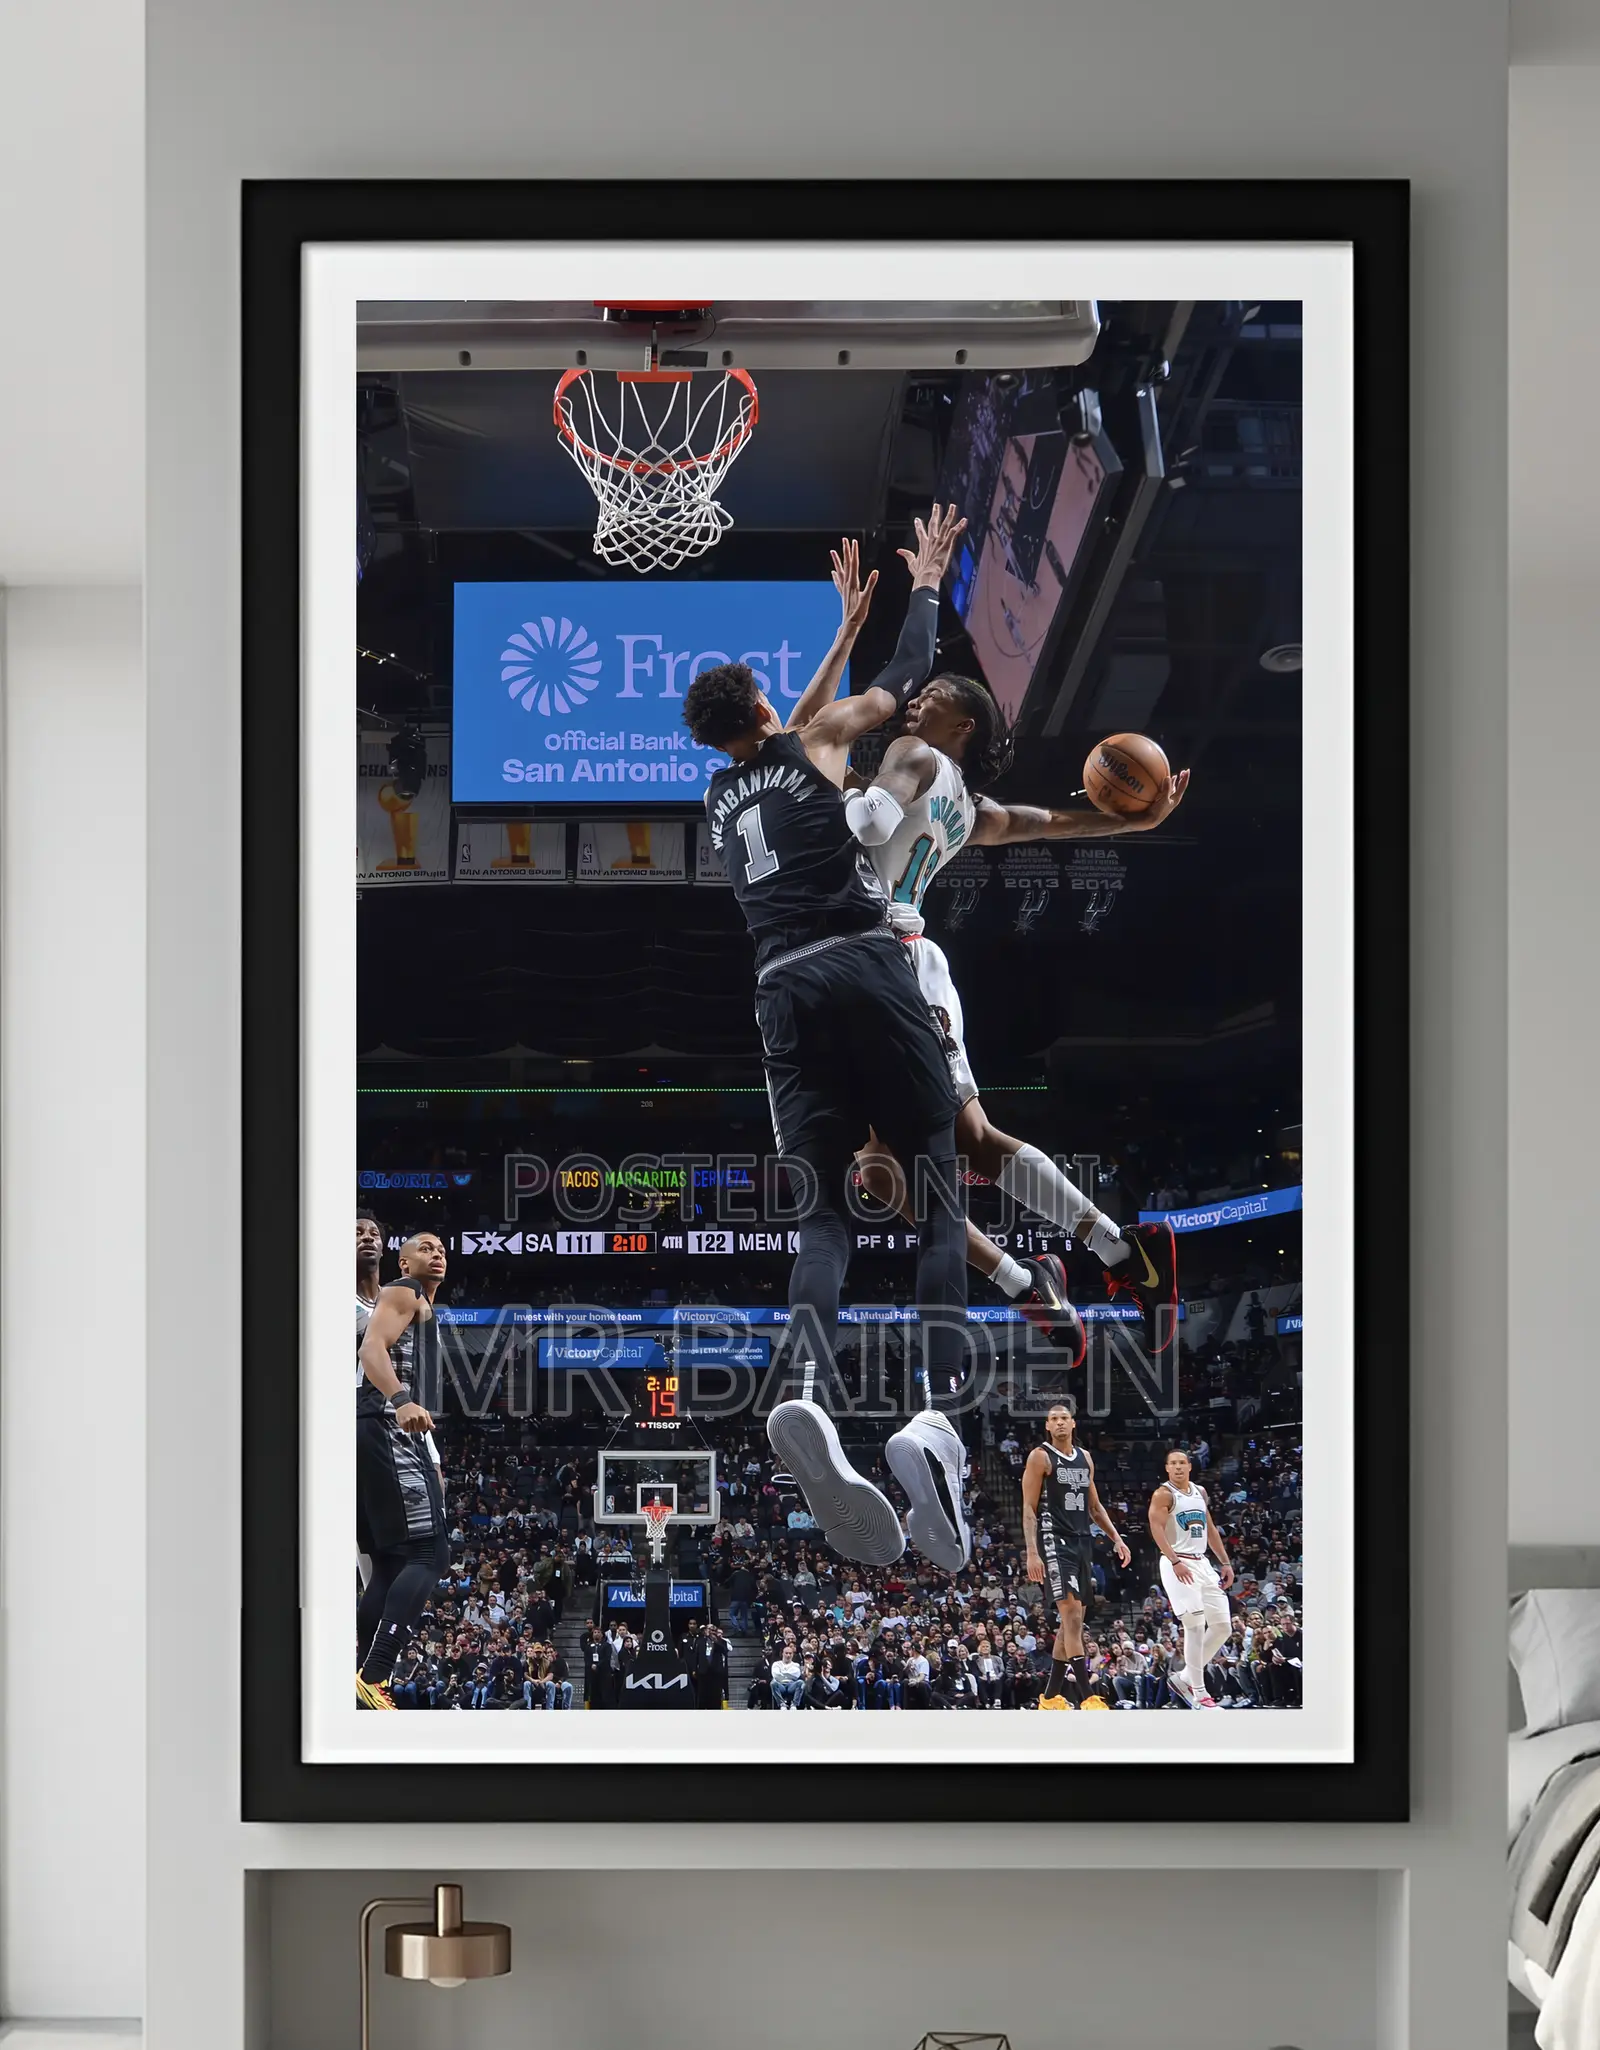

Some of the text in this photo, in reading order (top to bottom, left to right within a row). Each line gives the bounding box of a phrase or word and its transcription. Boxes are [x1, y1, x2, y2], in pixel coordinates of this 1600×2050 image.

[544, 730, 625, 750] Official
[630, 732, 687, 750] Bank
[502, 758, 565, 783] San
[570, 755, 699, 783] Antonio
[711, 765, 818, 851] WEMBANYAMA
[736, 802, 780, 885] 1
[936, 878, 989, 888] 2007
[1004, 878, 1059, 888] 2013
[1071, 879, 1124, 890] 2014
[359, 1171, 448, 1188] GLORIA
[560, 1170, 749, 1188] TACOS MARGARITAS CERVEZA
[1170, 1198, 1268, 1228] VictoryCapital
[525, 1234, 554, 1253] SA
[565, 1235, 592, 1252] 111
[612, 1235, 648, 1252] 2:10
[662, 1236, 683, 1249] 4TH
[696, 1234, 727, 1252] 122
[739, 1234, 782, 1251] MEM
[857, 1235, 881, 1248] PF
[1017, 1234, 1024, 1248] 2
[1041, 1240, 1048, 1251] 5
[1065, 1240, 1072, 1251] 6
[436, 1312, 477, 1324] yCapital
[513, 1312, 642, 1324] Invest with your home team
[679, 1311, 750, 1323] VictoryCapital
[860, 1311, 893, 1320] Mutual
[966, 1309, 1020, 1322] toryCapital
[1100, 1311, 1121, 1321] your
[555, 1345, 642, 1361] VictoryCapital
[647, 1377, 678, 1391] 2:10
[651, 1391, 675, 1417] 15
[648, 1422, 681, 1430] TISSOT
[647, 1643, 668, 1651] Frost
